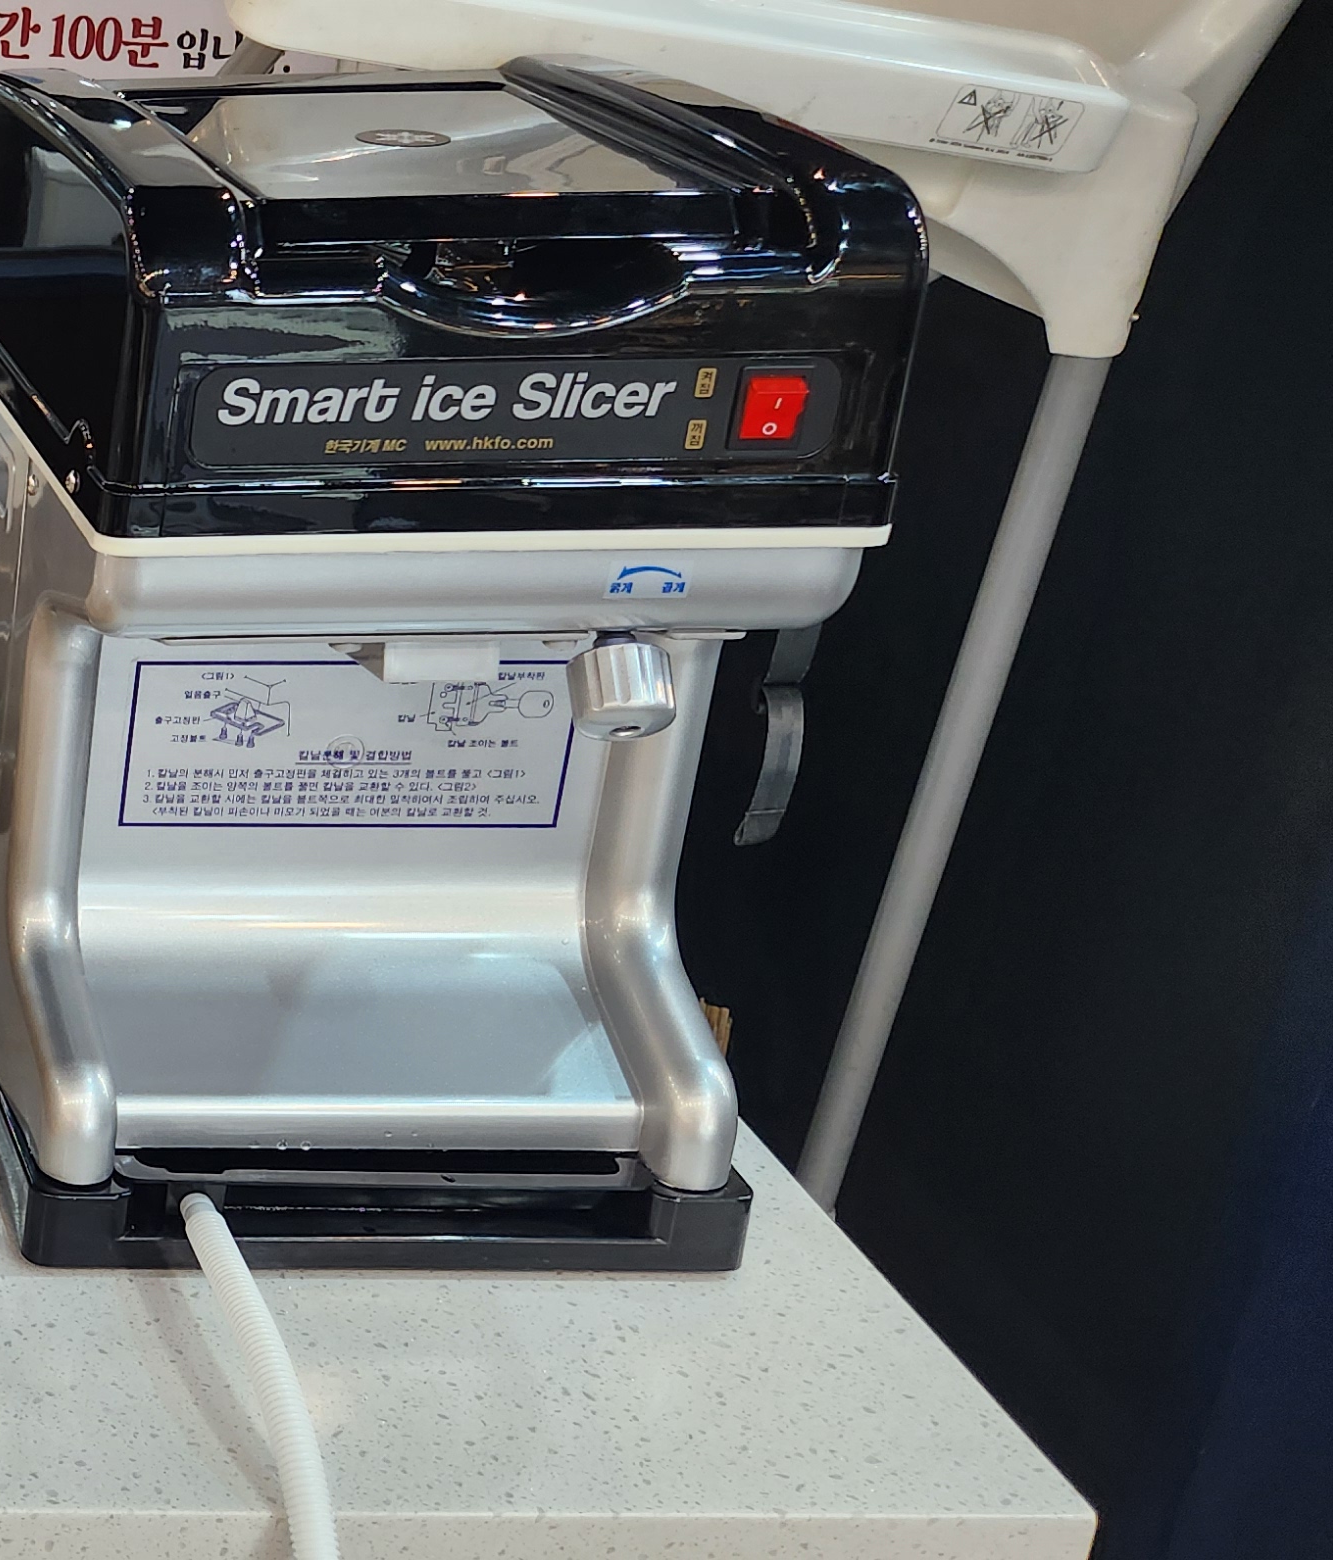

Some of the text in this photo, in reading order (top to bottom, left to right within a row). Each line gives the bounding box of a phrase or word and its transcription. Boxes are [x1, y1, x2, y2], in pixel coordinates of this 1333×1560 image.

[48, 14, 169, 69] 100분
[216, 371, 679, 427] Smart ice Slicer
[382, 438, 409, 453] MC
[424, 435, 555, 452] www.hkfo.com
